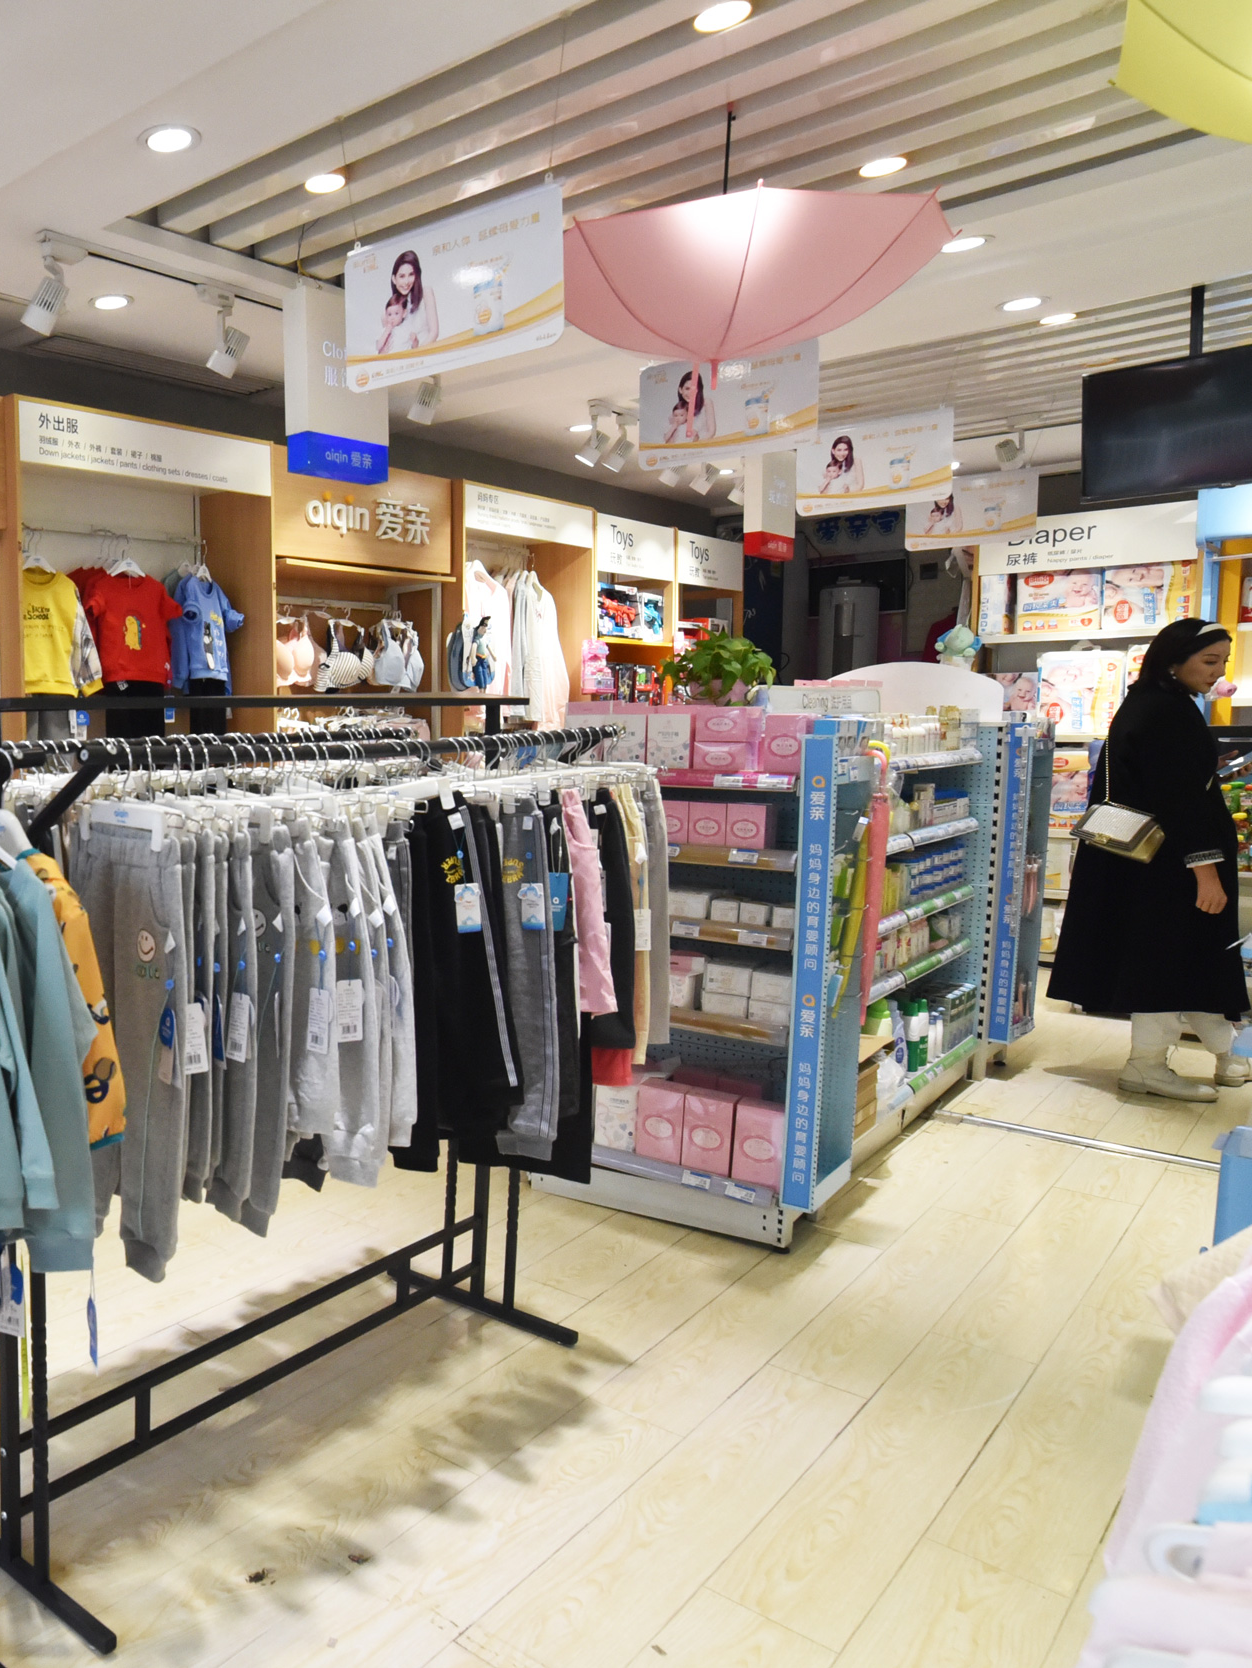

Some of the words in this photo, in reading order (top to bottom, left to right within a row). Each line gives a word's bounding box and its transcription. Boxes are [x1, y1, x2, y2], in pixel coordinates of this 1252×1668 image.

[38, 412, 79, 435] 外出服
[38, 446, 60, 457] Down
[60, 450, 86, 462] jackets
[90, 456, 116, 467] jackets
[119, 460, 138, 470] pants
[142, 464, 167, 476] clothing
[325, 449, 349, 464] aiqin
[351, 451, 373, 470] 爱亲
[305, 491, 370, 534] aiqin
[375, 498, 431, 545] 爱亲
[610, 524, 634, 551] Toys
[1008, 525, 1097, 548] aper
[689, 540, 710, 565] Toys
[1006, 552, 1039, 567] 尿裤
[809, 791, 826, 821] 爱亲
[803, 843, 823, 972] 妈妈身边的育婴顾问
[799, 1009, 816, 1039] 爱亲
[791, 1062, 812, 1186] 妈妈身边的育婴顾问
